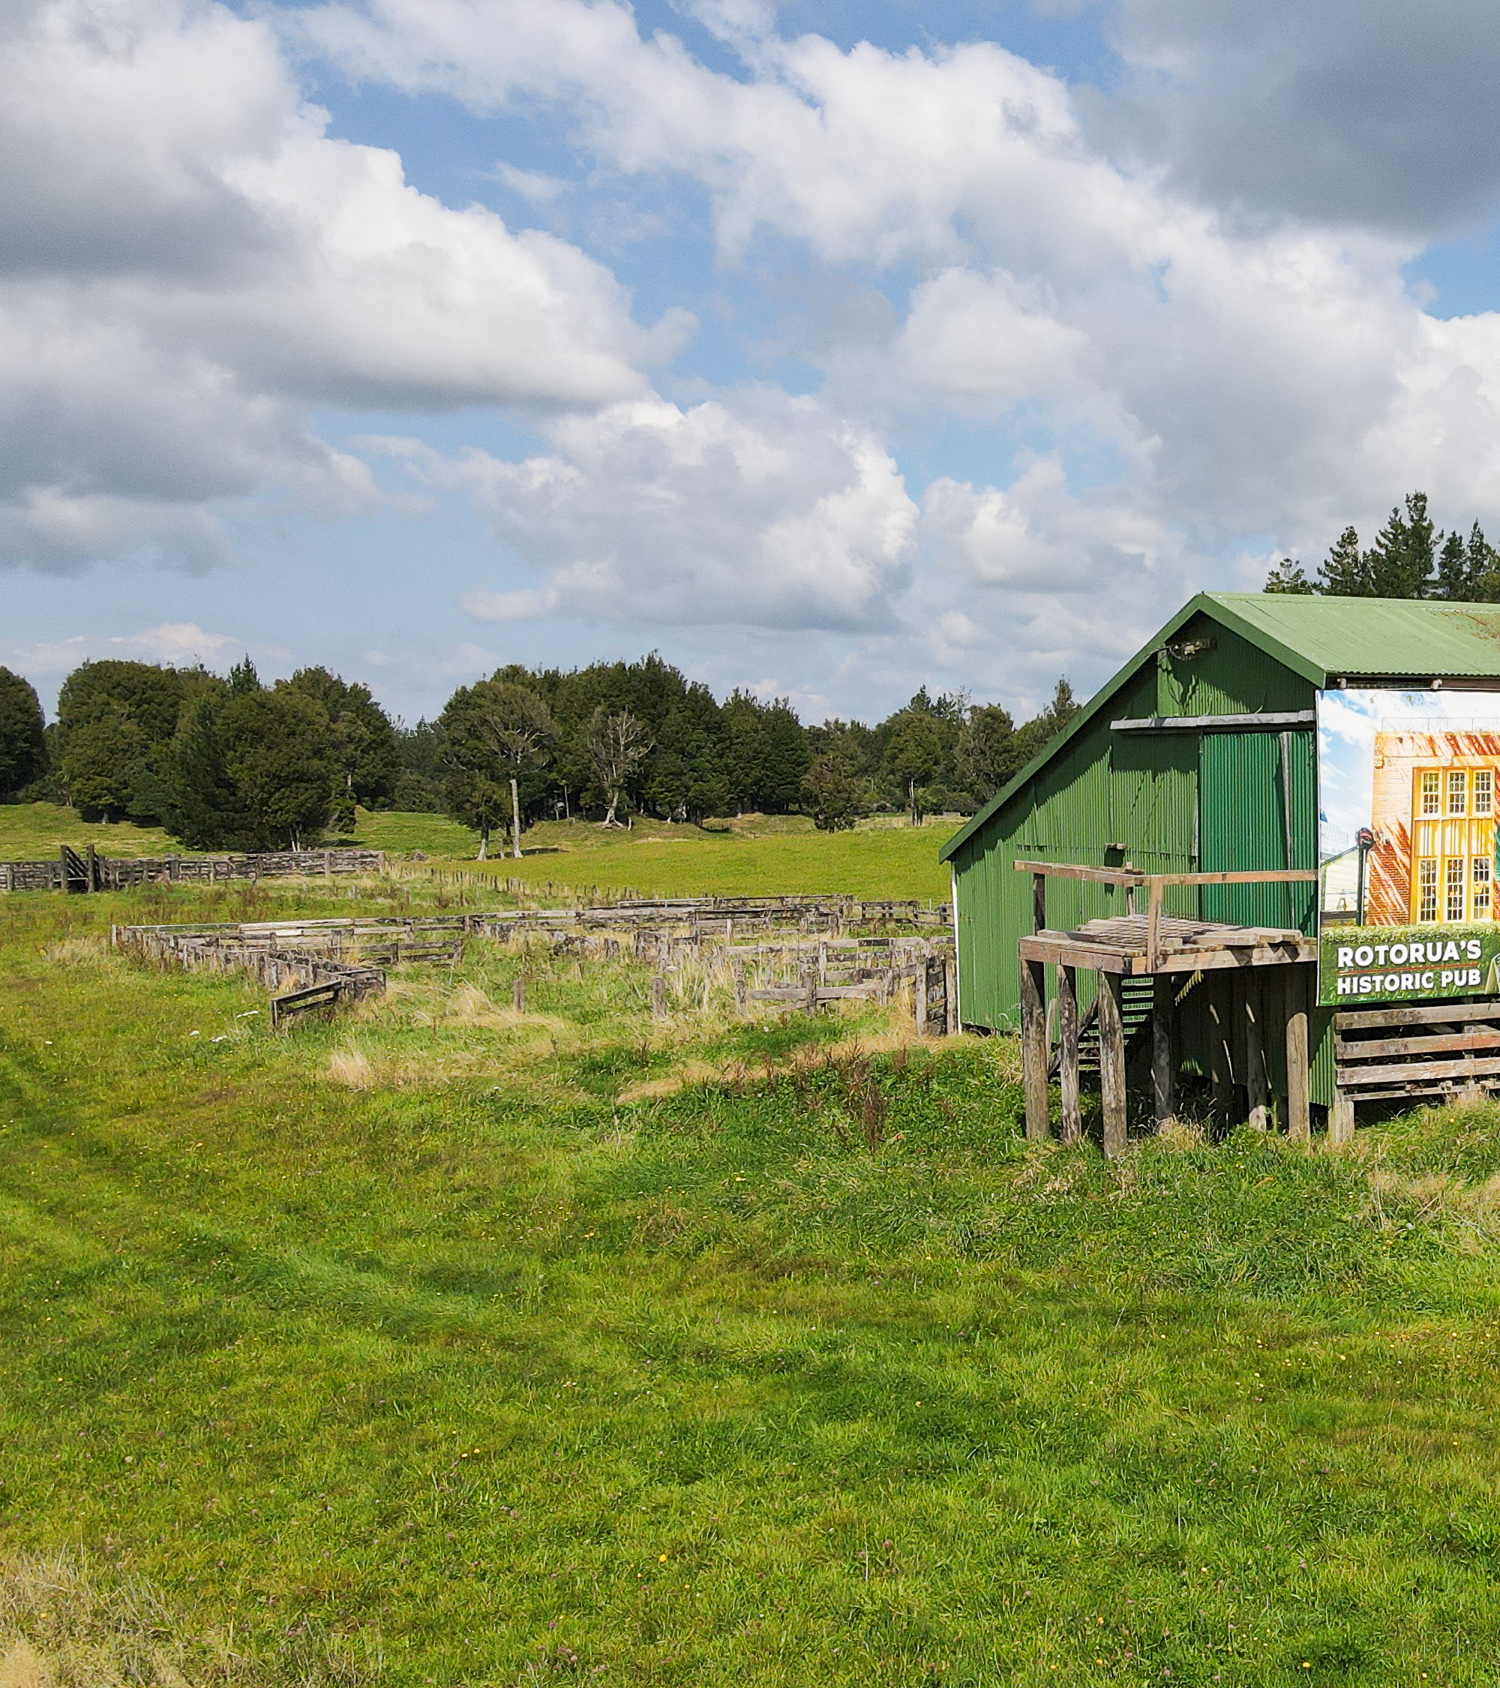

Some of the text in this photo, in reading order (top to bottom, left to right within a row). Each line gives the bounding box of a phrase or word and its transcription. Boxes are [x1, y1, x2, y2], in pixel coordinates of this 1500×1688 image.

[1337, 939, 1482, 968] ROTORUA'S
[1337, 969, 1481, 995] HISTORIC PUB
